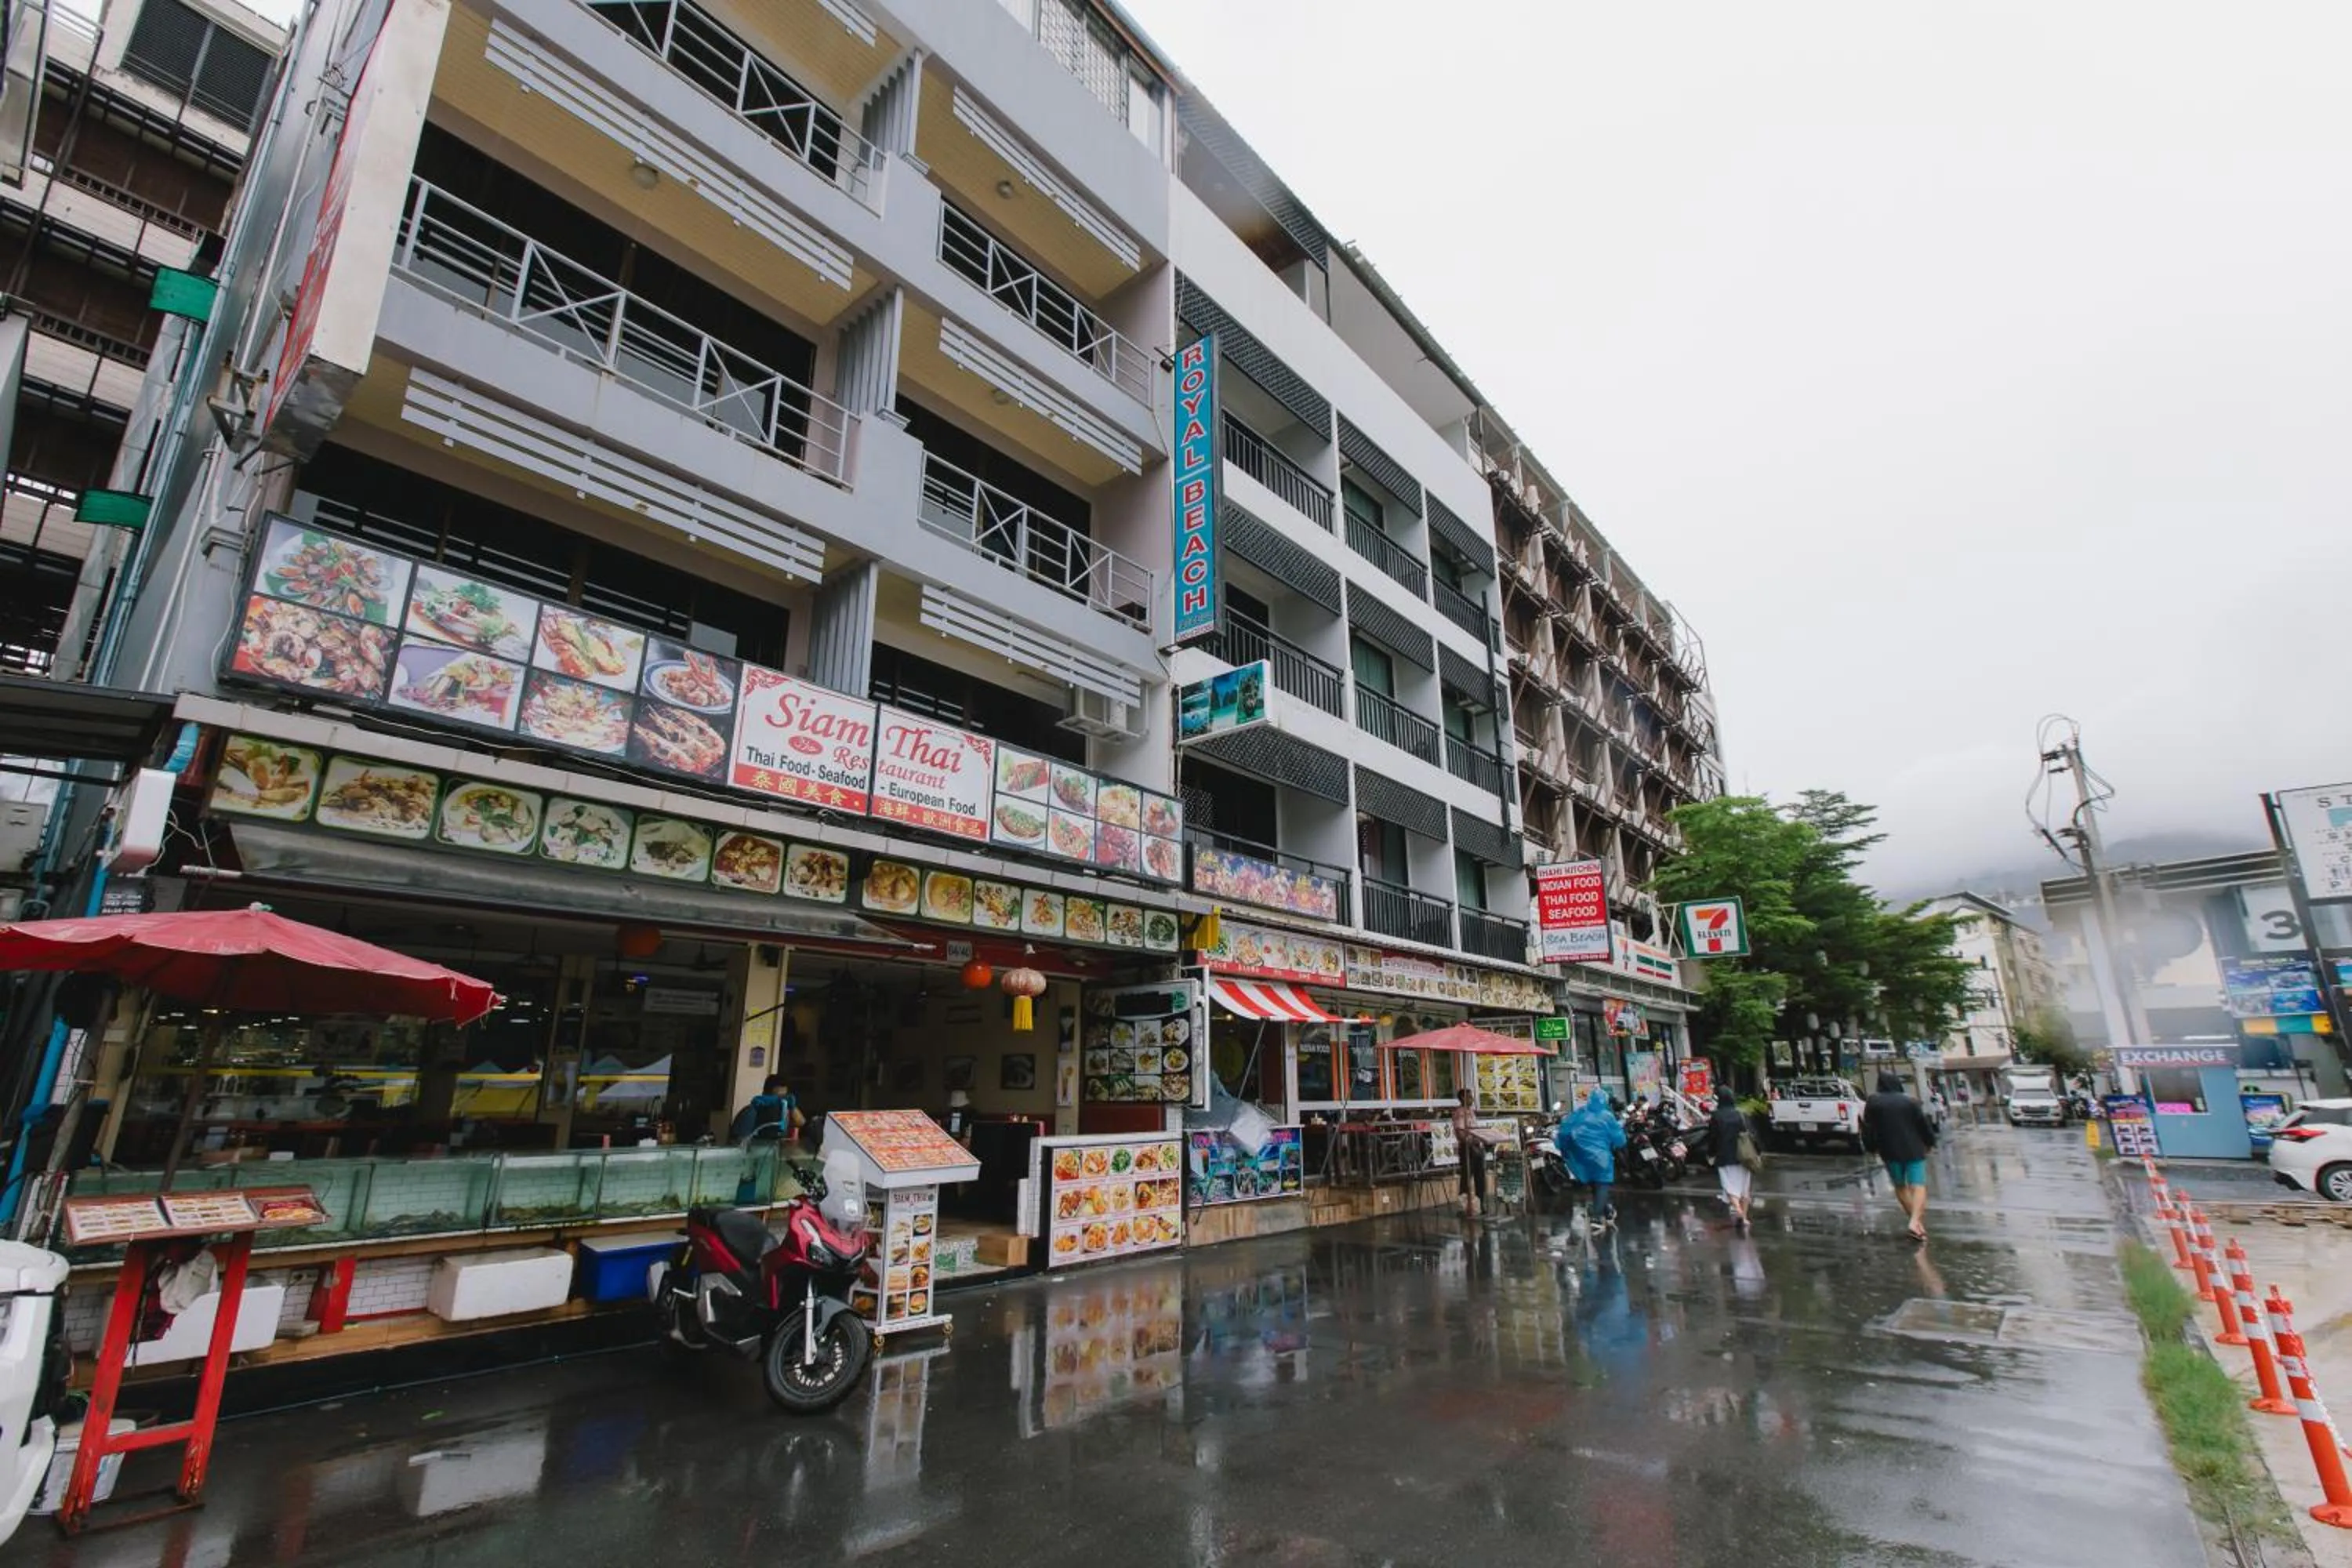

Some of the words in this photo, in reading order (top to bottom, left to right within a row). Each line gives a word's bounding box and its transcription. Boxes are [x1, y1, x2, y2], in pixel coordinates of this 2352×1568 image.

[1180, 343, 1207, 469] ROYAL
[1180, 479, 1207, 616] BEACH
[765, 692, 869, 749] Siam
[886, 725, 966, 773] Thai
[746, 746, 775, 768] Thai
[779, 754, 811, 776] Food
[818, 764, 866, 789] Seafood
[888, 782, 946, 807] European
[949, 797, 976, 816] Food
[1539, 880, 1572, 891] INDIAN
[1573, 877, 1601, 888] FOOD
[1544, 895, 1568, 906] THAI
[1570, 891, 1599, 904] FOOD
[1548, 906, 1597, 920] SEAFOOD
[1695, 908, 1729, 953] 7
[2120, 1049, 2227, 1063] EXCHANGE
